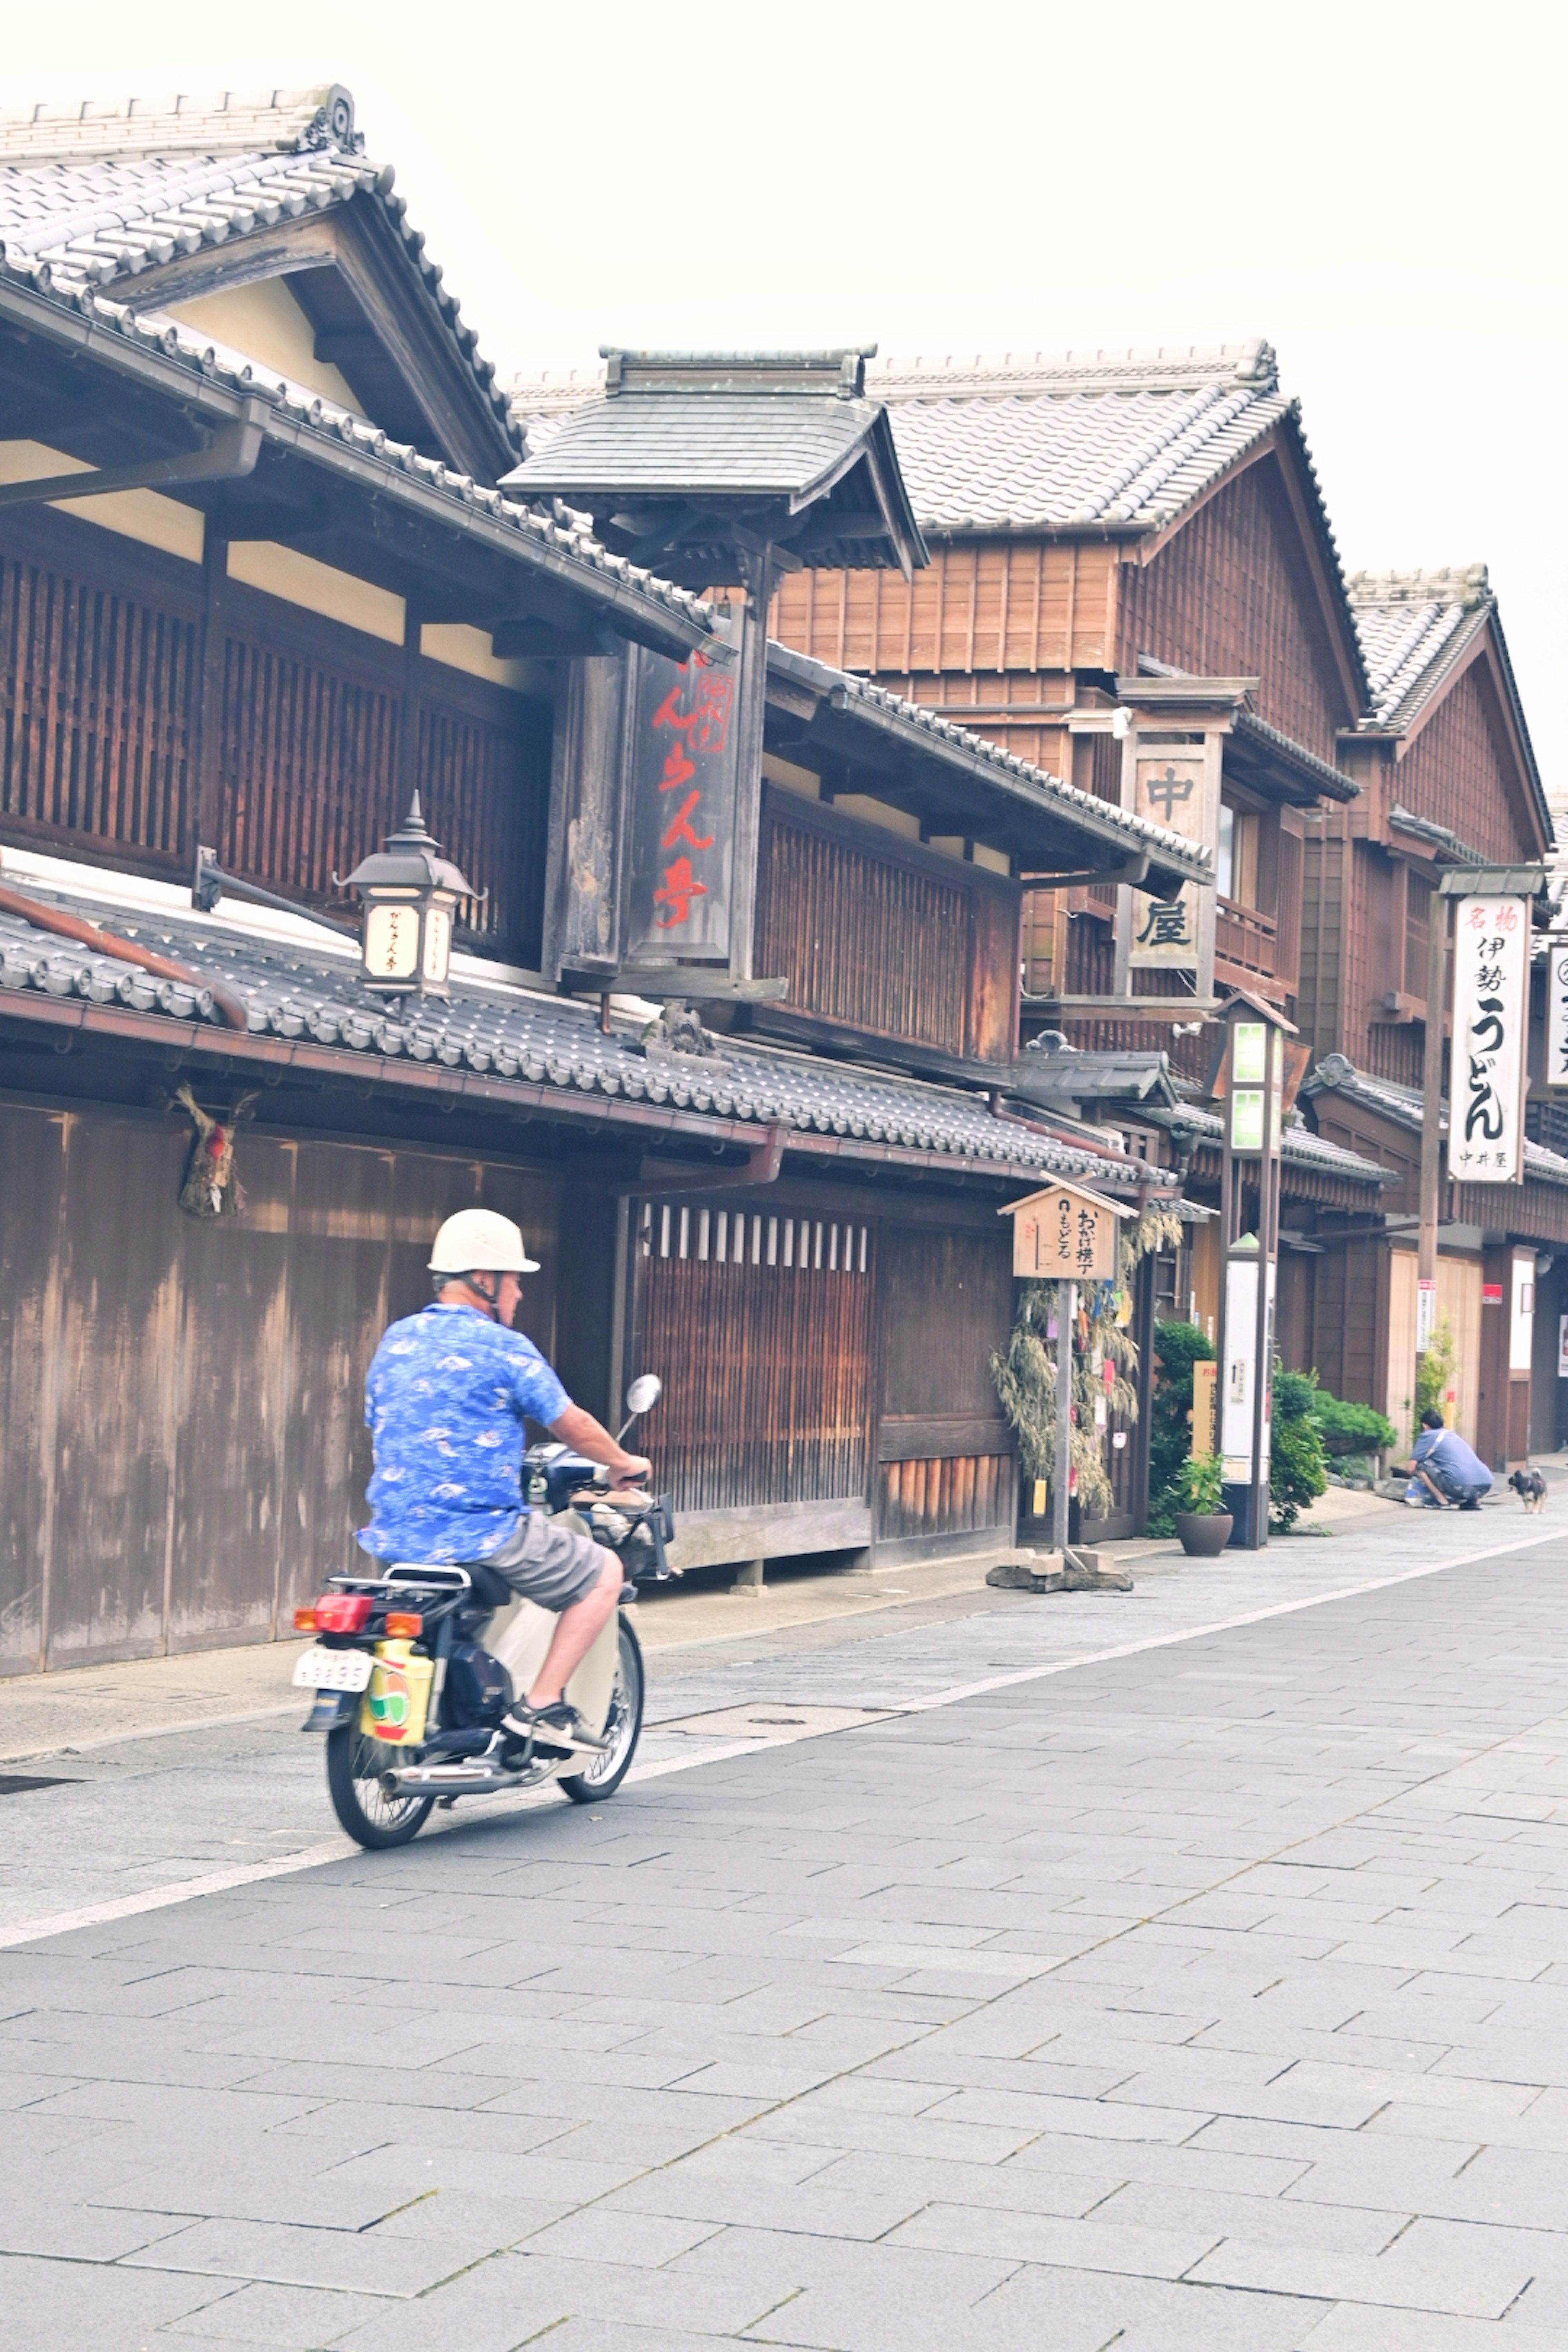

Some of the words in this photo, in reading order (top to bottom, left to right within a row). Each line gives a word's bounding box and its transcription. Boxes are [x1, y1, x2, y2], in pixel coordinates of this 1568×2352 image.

[1137, 766, 1194, 946] 中屋
[1465, 906, 1518, 933] 名物
[1465, 937, 1507, 1142] 伊勢うどん
[1459, 1150, 1508, 1168] 中井屋
[1058, 1213, 1072, 1259] もどる
[1076, 1209, 1098, 1274] おかげ横丁
